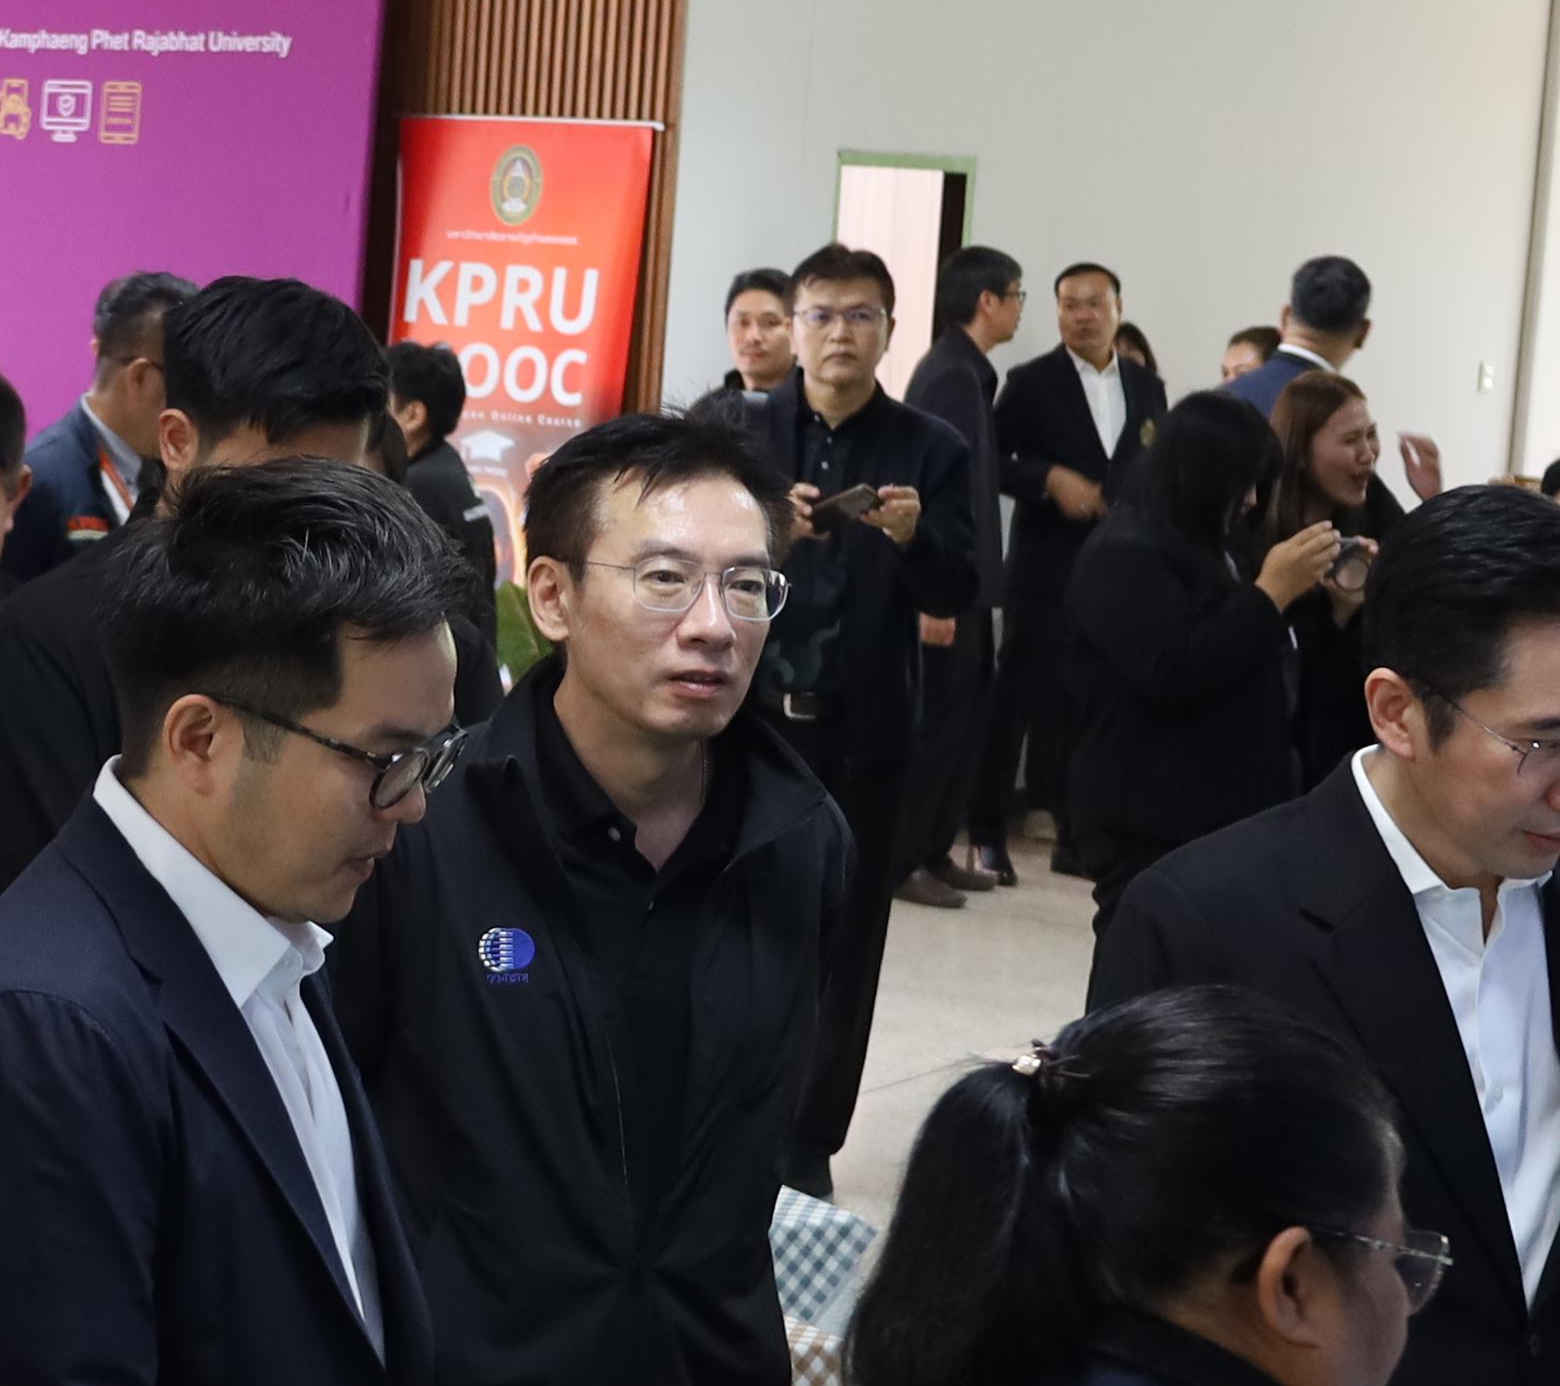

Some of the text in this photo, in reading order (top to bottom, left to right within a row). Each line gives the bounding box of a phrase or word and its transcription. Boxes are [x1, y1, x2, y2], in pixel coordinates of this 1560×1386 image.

[90, 29, 130, 51] Phet
[131, 30, 206, 56] Rajabhat
[207, 30, 293, 58] University
[403, 257, 600, 336] KPRU
[458, 343, 588, 406] OOC
